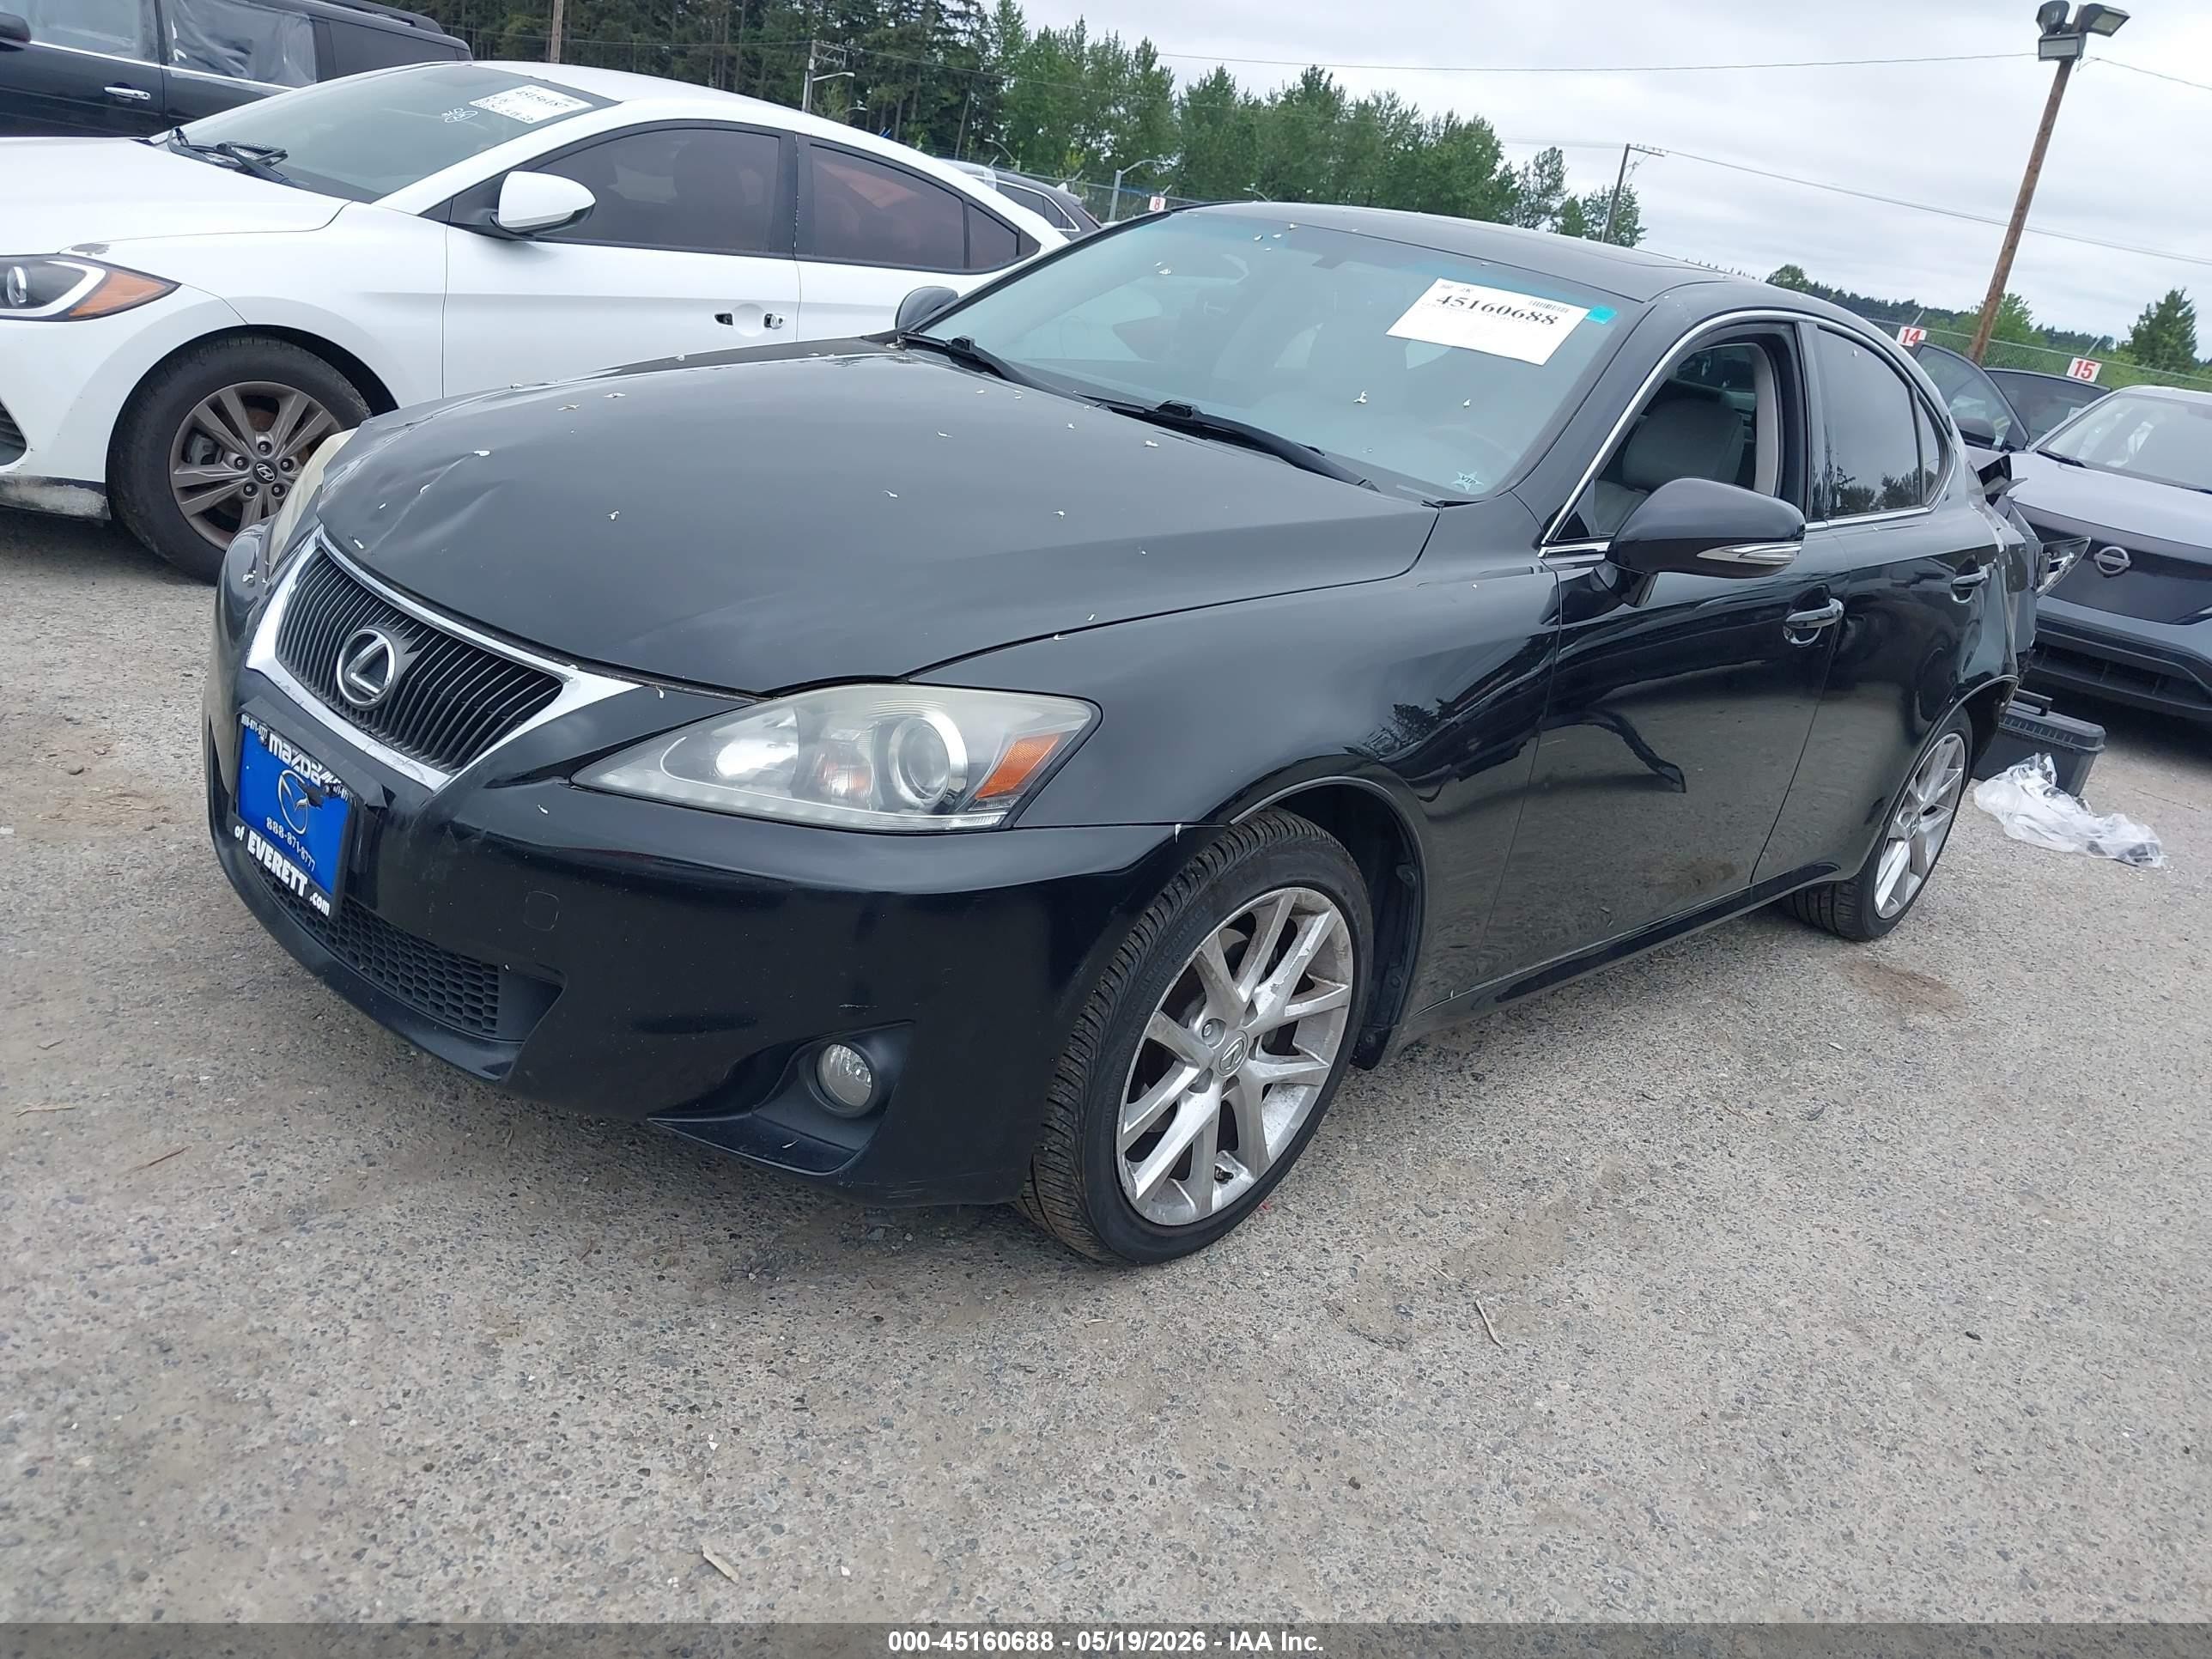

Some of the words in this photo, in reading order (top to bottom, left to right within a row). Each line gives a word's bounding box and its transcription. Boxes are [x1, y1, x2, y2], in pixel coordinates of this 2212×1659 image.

[1154, 198, 1161, 210] 8
[1436, 295, 1559, 325] 45160688
[1902, 328, 1923, 344] 14
[2073, 361, 2096, 380] 15
[1461, 475, 1477, 484] VIP
[234, 825, 245, 842] of
[247, 830, 308, 898] EVERETT
